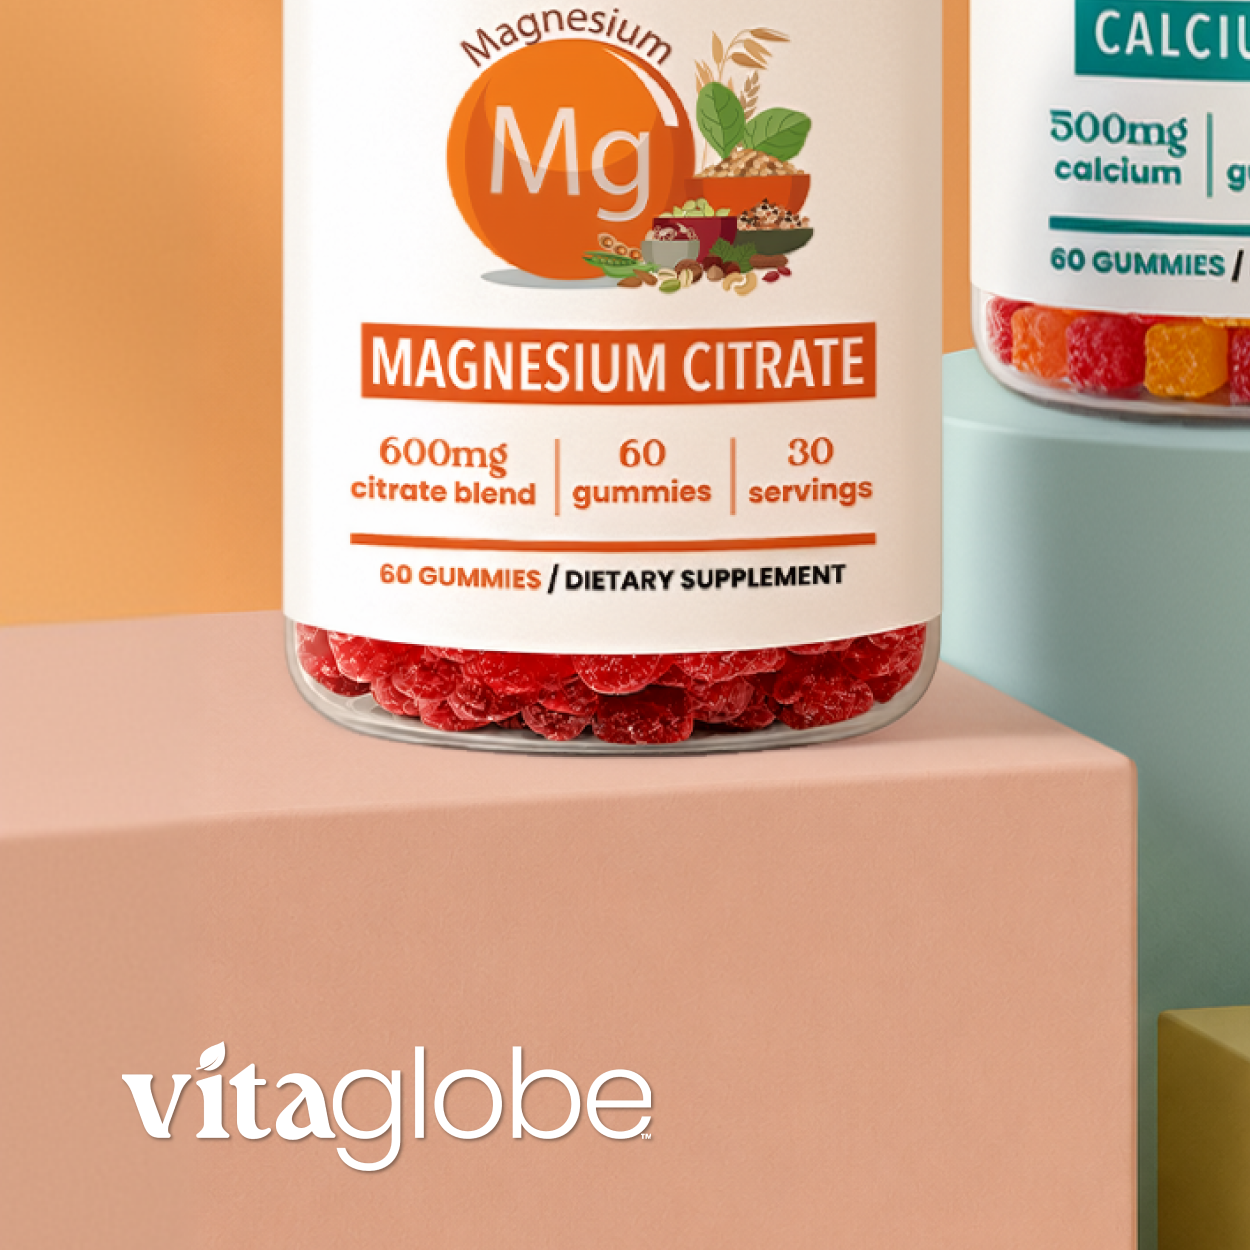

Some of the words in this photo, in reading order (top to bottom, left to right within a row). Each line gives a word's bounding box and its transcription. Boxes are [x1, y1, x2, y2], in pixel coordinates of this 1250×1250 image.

[460, 8, 672, 67] Magnesium
[1050, 110, 1188, 156] 500mg
[491, 105, 649, 222] Mg
[1055, 157, 1182, 185] calcium
[1051, 248, 1085, 271] 60
[1092, 251, 1225, 276] GUMMIES
[373, 337, 665, 392] MAGNESIUM
[684, 337, 863, 391] CITRATE
[380, 437, 507, 478] 600mg
[620, 439, 666, 467] 60
[788, 437, 834, 466] 30
[351, 476, 447, 502] citrate
[455, 476, 535, 505] blend
[573, 479, 711, 510] gummies
[749, 478, 873, 506] servings
[380, 564, 412, 584] 60
[419, 566, 541, 590] GUMMIES
[566, 570, 674, 591] DIETARY
[681, 564, 846, 589] SUPPLEMENT
